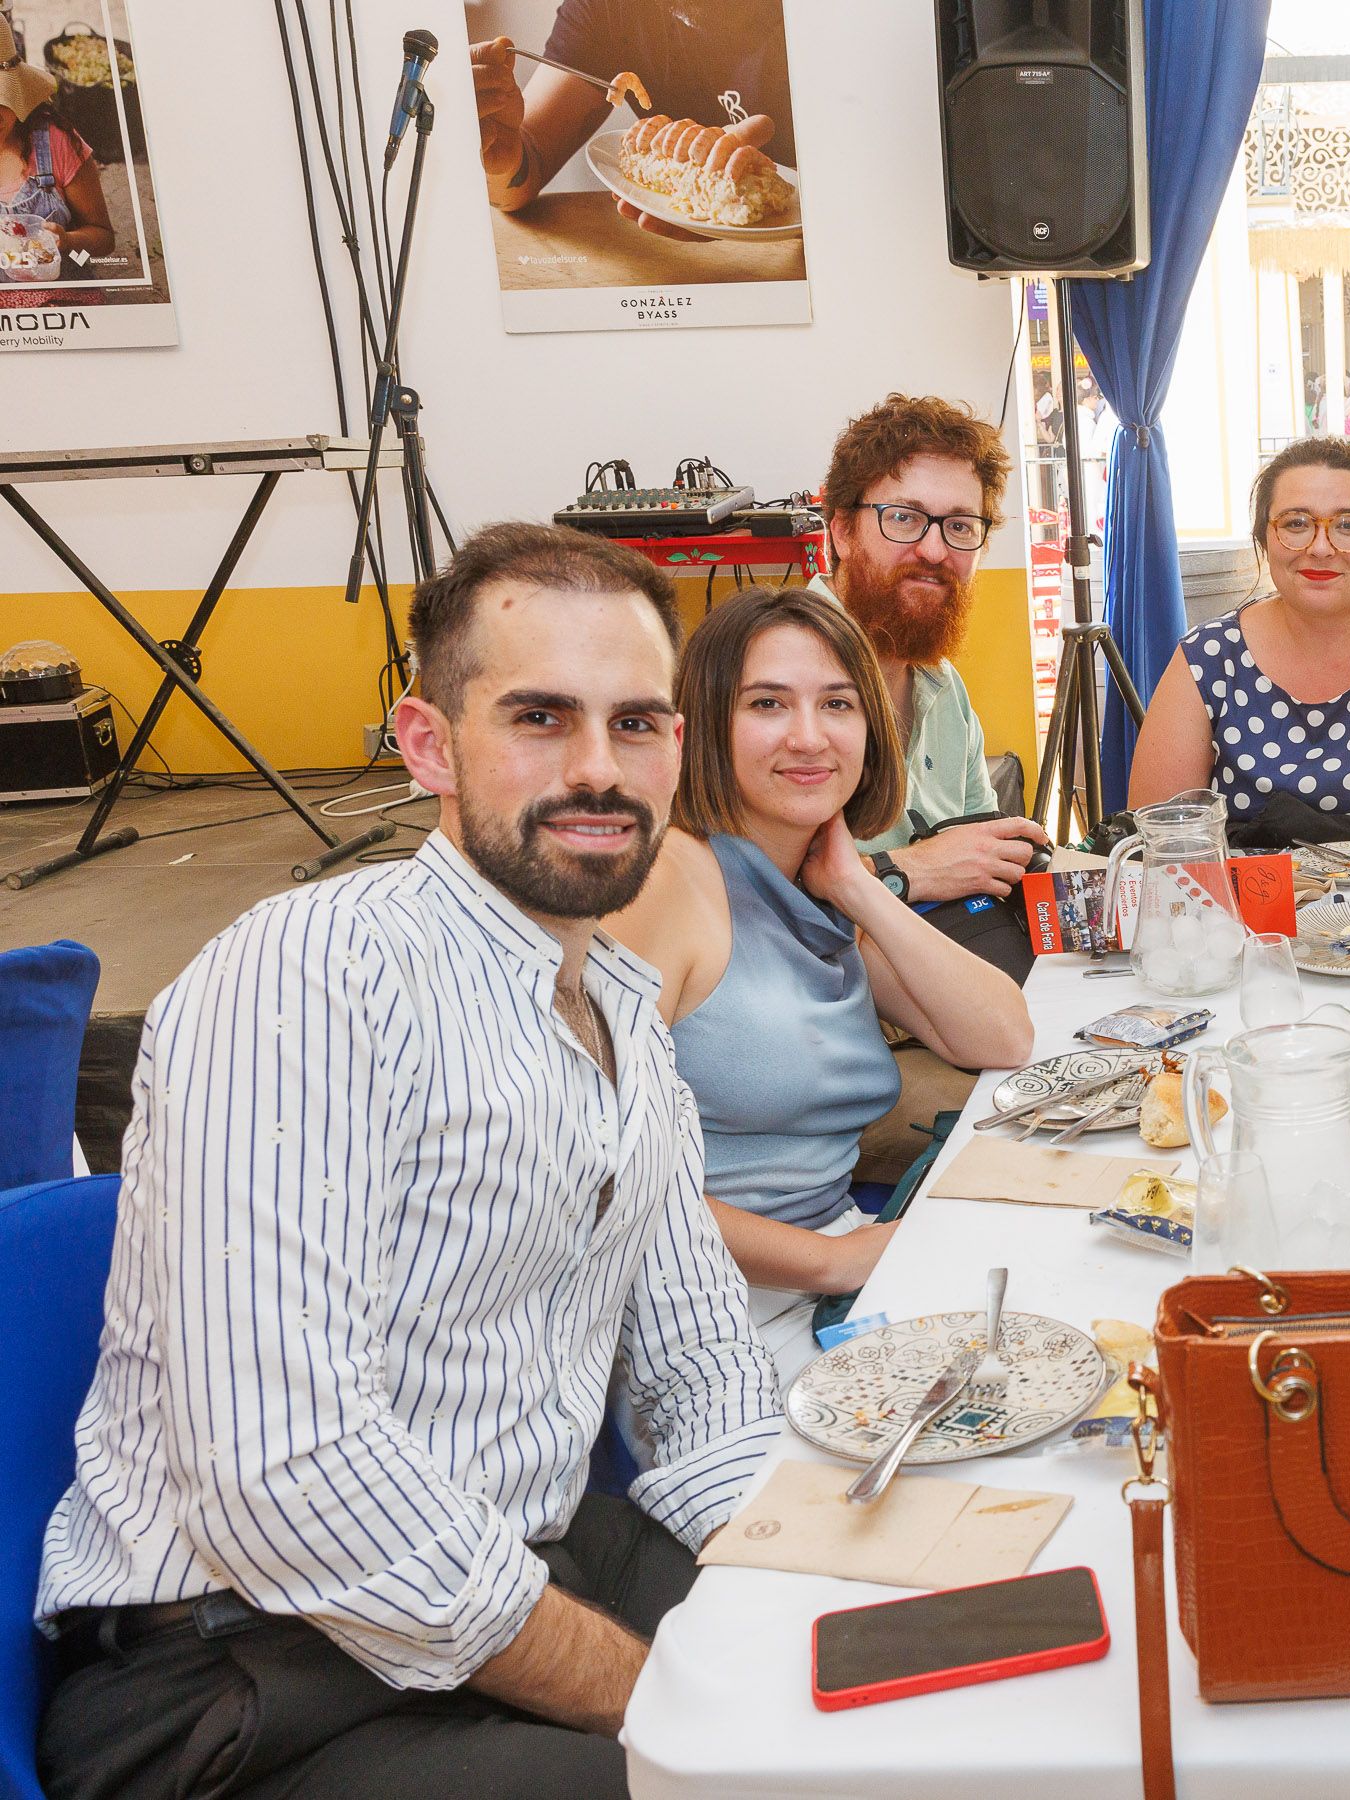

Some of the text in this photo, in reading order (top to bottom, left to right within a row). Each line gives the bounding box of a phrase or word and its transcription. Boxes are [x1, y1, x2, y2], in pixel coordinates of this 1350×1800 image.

[637, 310, 678, 320] BYASS
[22, 335, 64, 347] Mobility
[1119, 880, 1130, 918] Conciertos
[1129, 880, 1138, 908] Eventos
[1036, 901, 1056, 951] Carta de Feria
